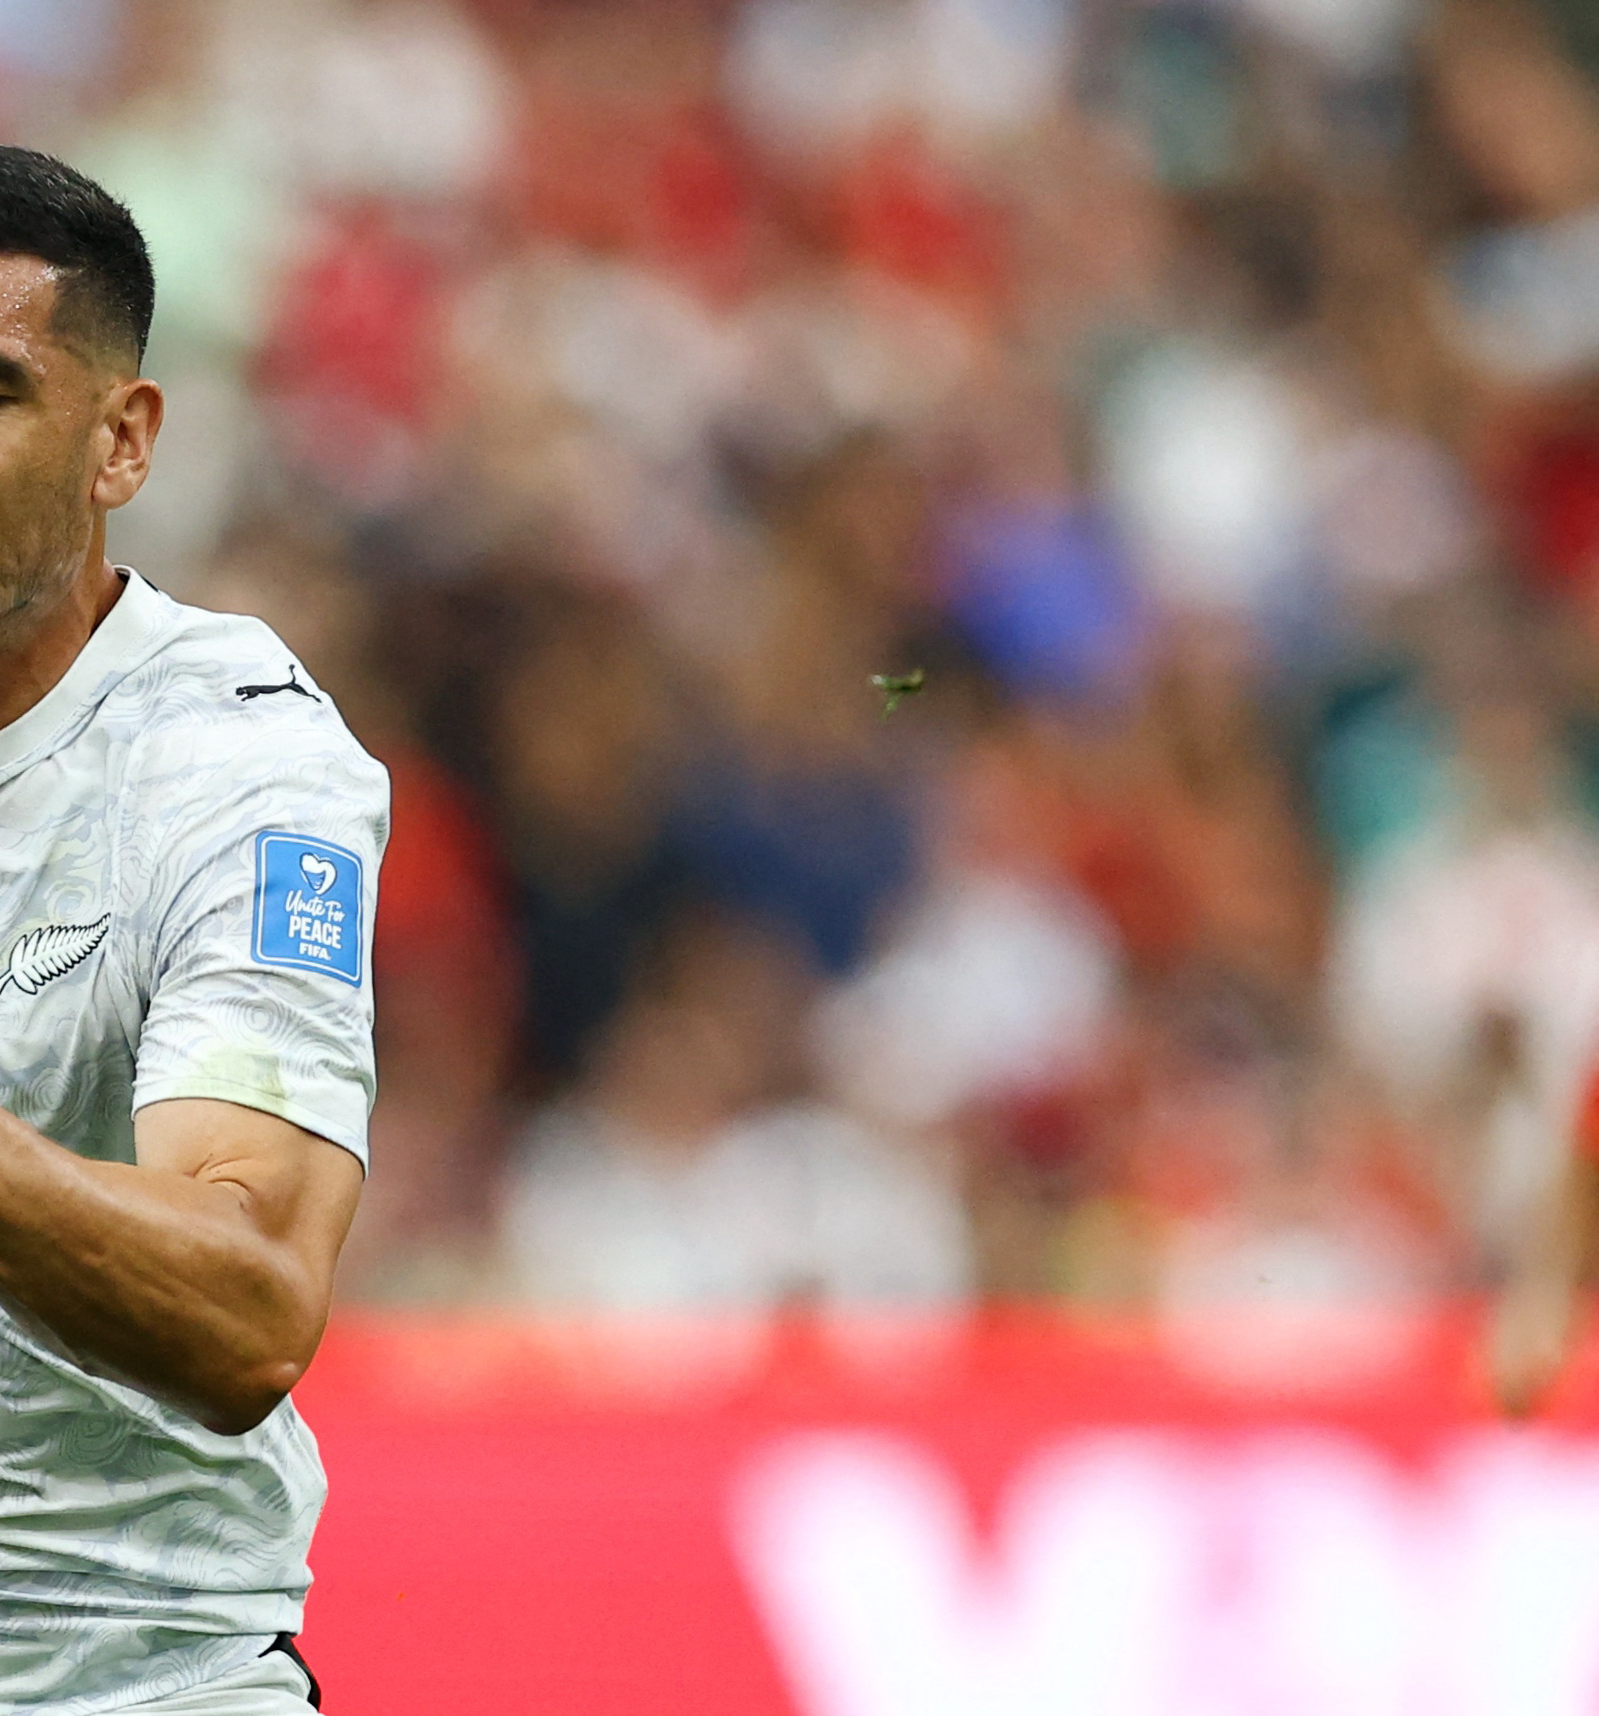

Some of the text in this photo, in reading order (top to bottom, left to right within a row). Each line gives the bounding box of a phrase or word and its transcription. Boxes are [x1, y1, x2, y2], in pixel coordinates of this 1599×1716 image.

[285, 889, 346, 922] Unite For
[288, 914, 342, 949] PEACE
[299, 942, 331, 961] FIFA
